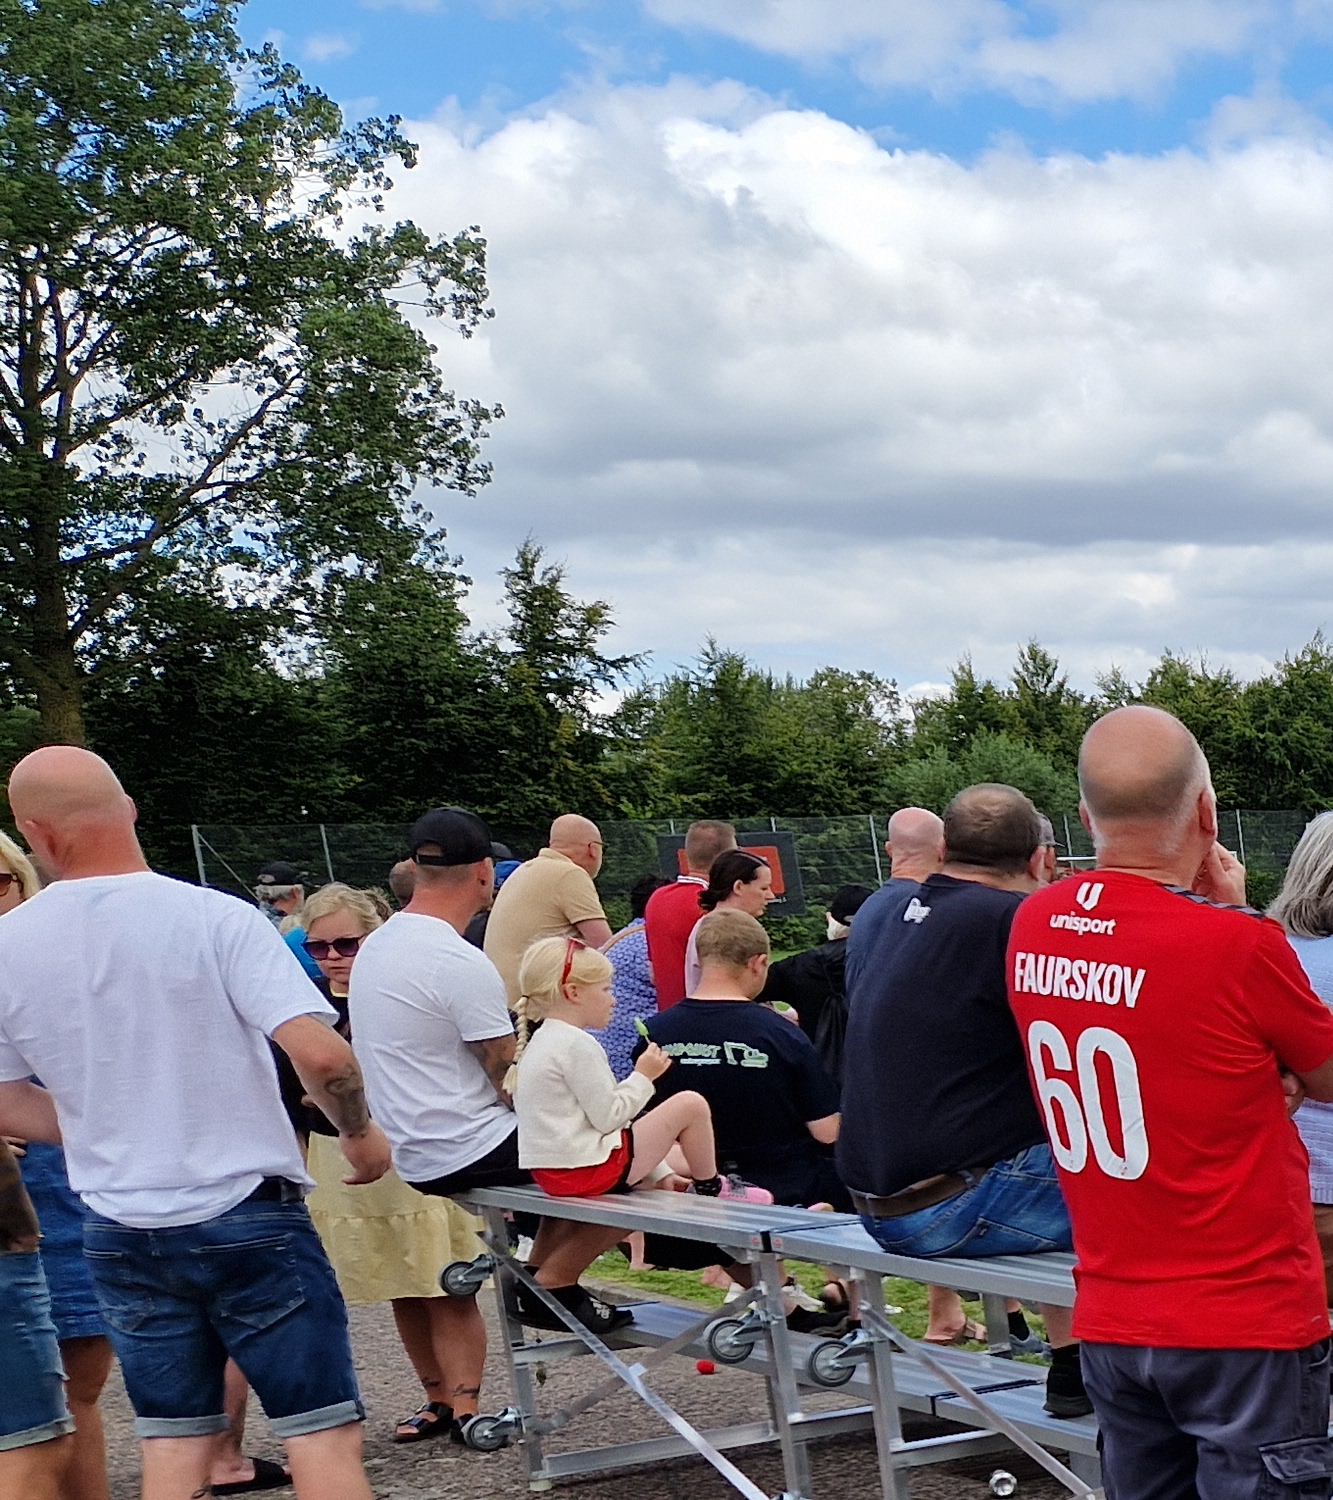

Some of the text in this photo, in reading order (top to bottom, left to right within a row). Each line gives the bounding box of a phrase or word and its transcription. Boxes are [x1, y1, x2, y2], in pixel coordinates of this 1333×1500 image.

[1050, 911, 1117, 936] unisport
[1014, 951, 1146, 1008] FAURSKOV
[1028, 1020, 1149, 1181] 60
